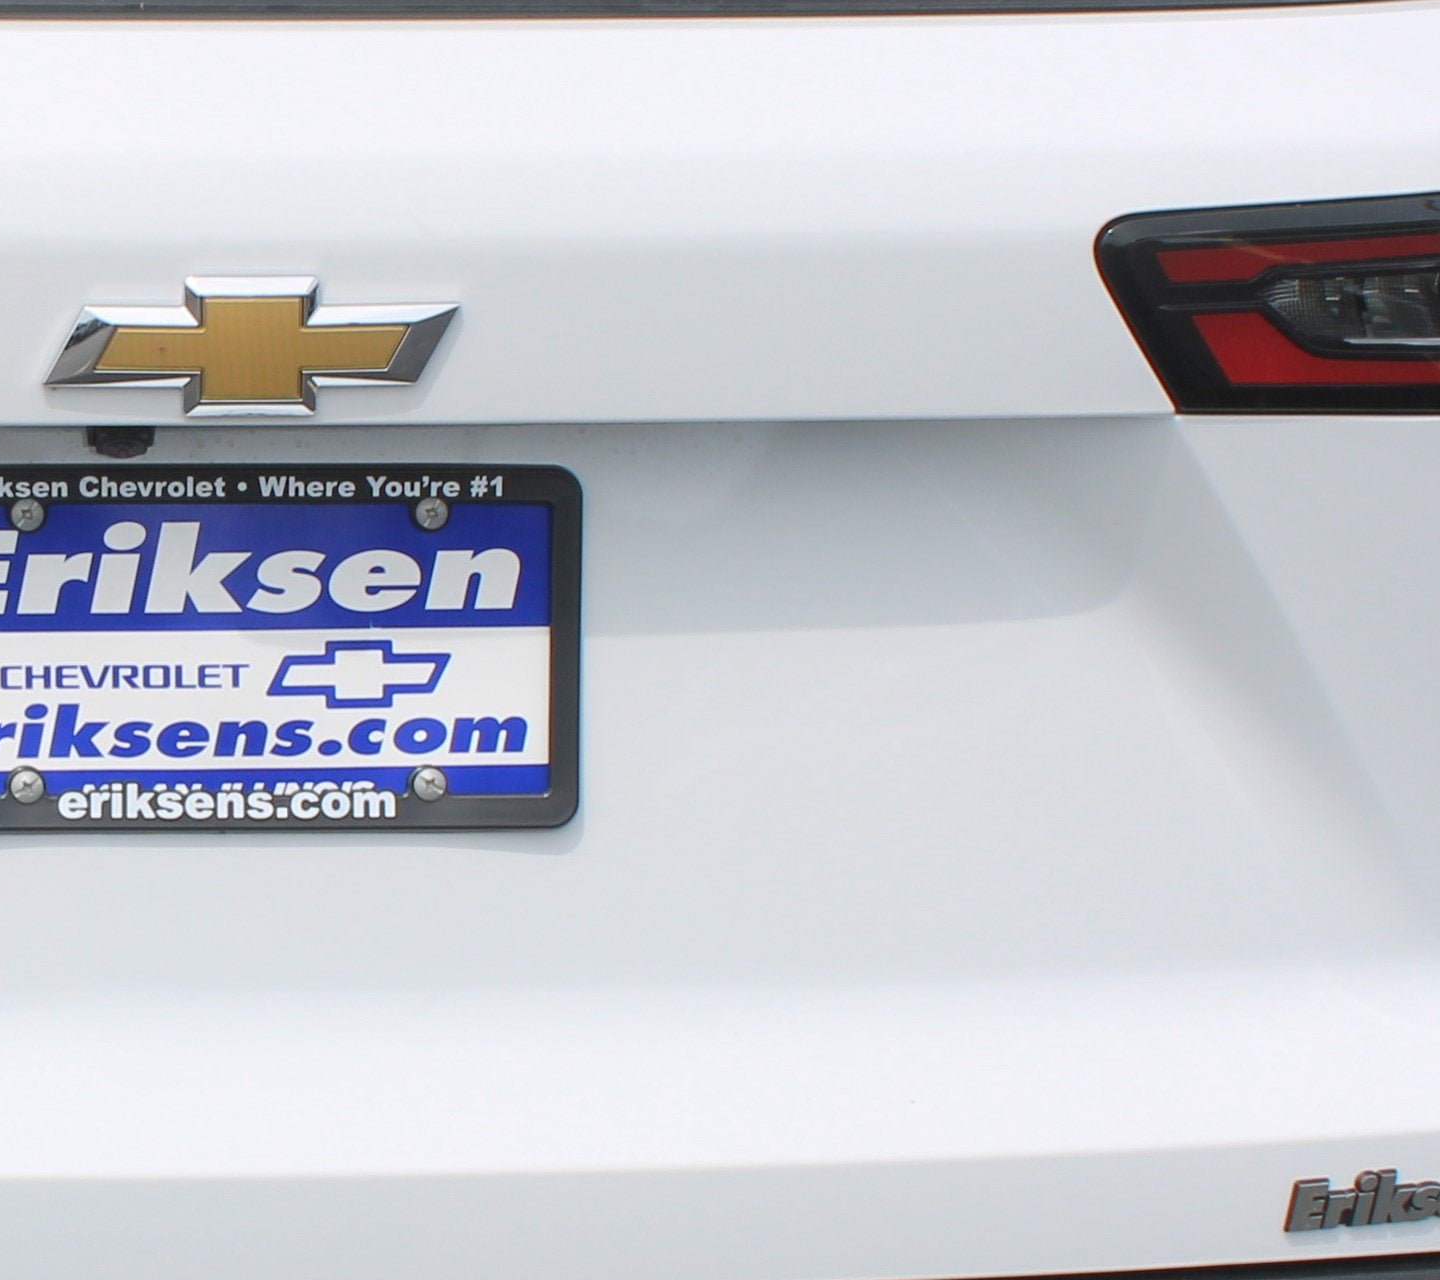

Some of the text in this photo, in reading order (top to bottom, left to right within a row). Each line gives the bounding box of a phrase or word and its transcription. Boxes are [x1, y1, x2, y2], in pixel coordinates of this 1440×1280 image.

[78, 475, 226, 499] Chevrolet
[258, 476, 356, 498] Where
[366, 475, 461, 499] You're
[470, 475, 506, 498] #1
[0, 664, 250, 690] CHEVROLET
[58, 784, 398, 820] eriksens.com
